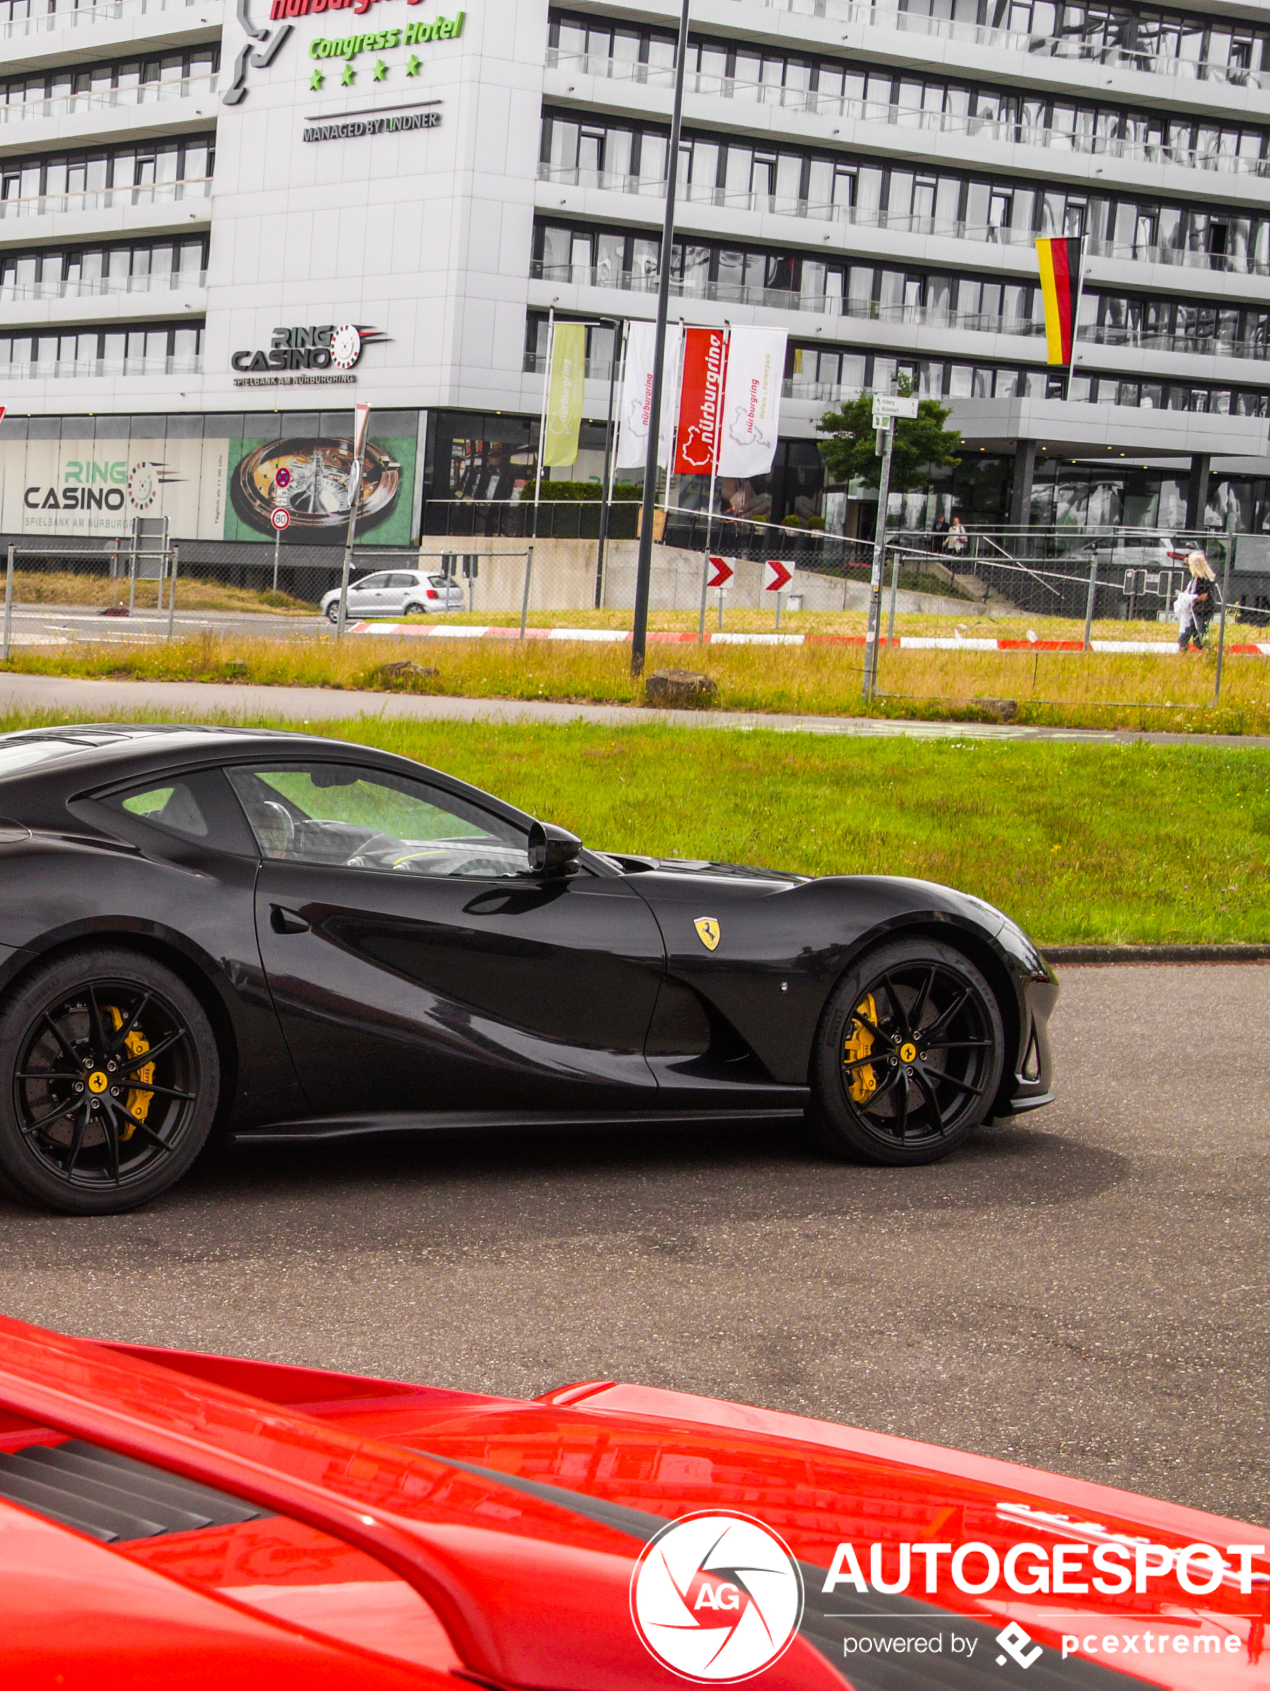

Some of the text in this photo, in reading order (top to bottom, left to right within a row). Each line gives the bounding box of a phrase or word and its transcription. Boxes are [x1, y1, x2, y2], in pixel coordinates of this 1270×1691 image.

[308, 11, 467, 61] Congress Hotel
[303, 121, 365, 142] MANAGED
[366, 119, 380, 135] BY
[271, 325, 334, 348] RING
[231, 347, 332, 371] CASINO
[233, 374, 357, 387] SPIELBANK AM NÜRBURGRING
[559, 358, 573, 423] nürburgring
[746, 378, 760, 434] nürburgring
[64, 461, 127, 484] RING
[23, 487, 125, 511] CASINO
[25, 518, 70, 528] SPIELBANK
[72, 518, 85, 528] AM
[275, 513, 286, 524] 80
